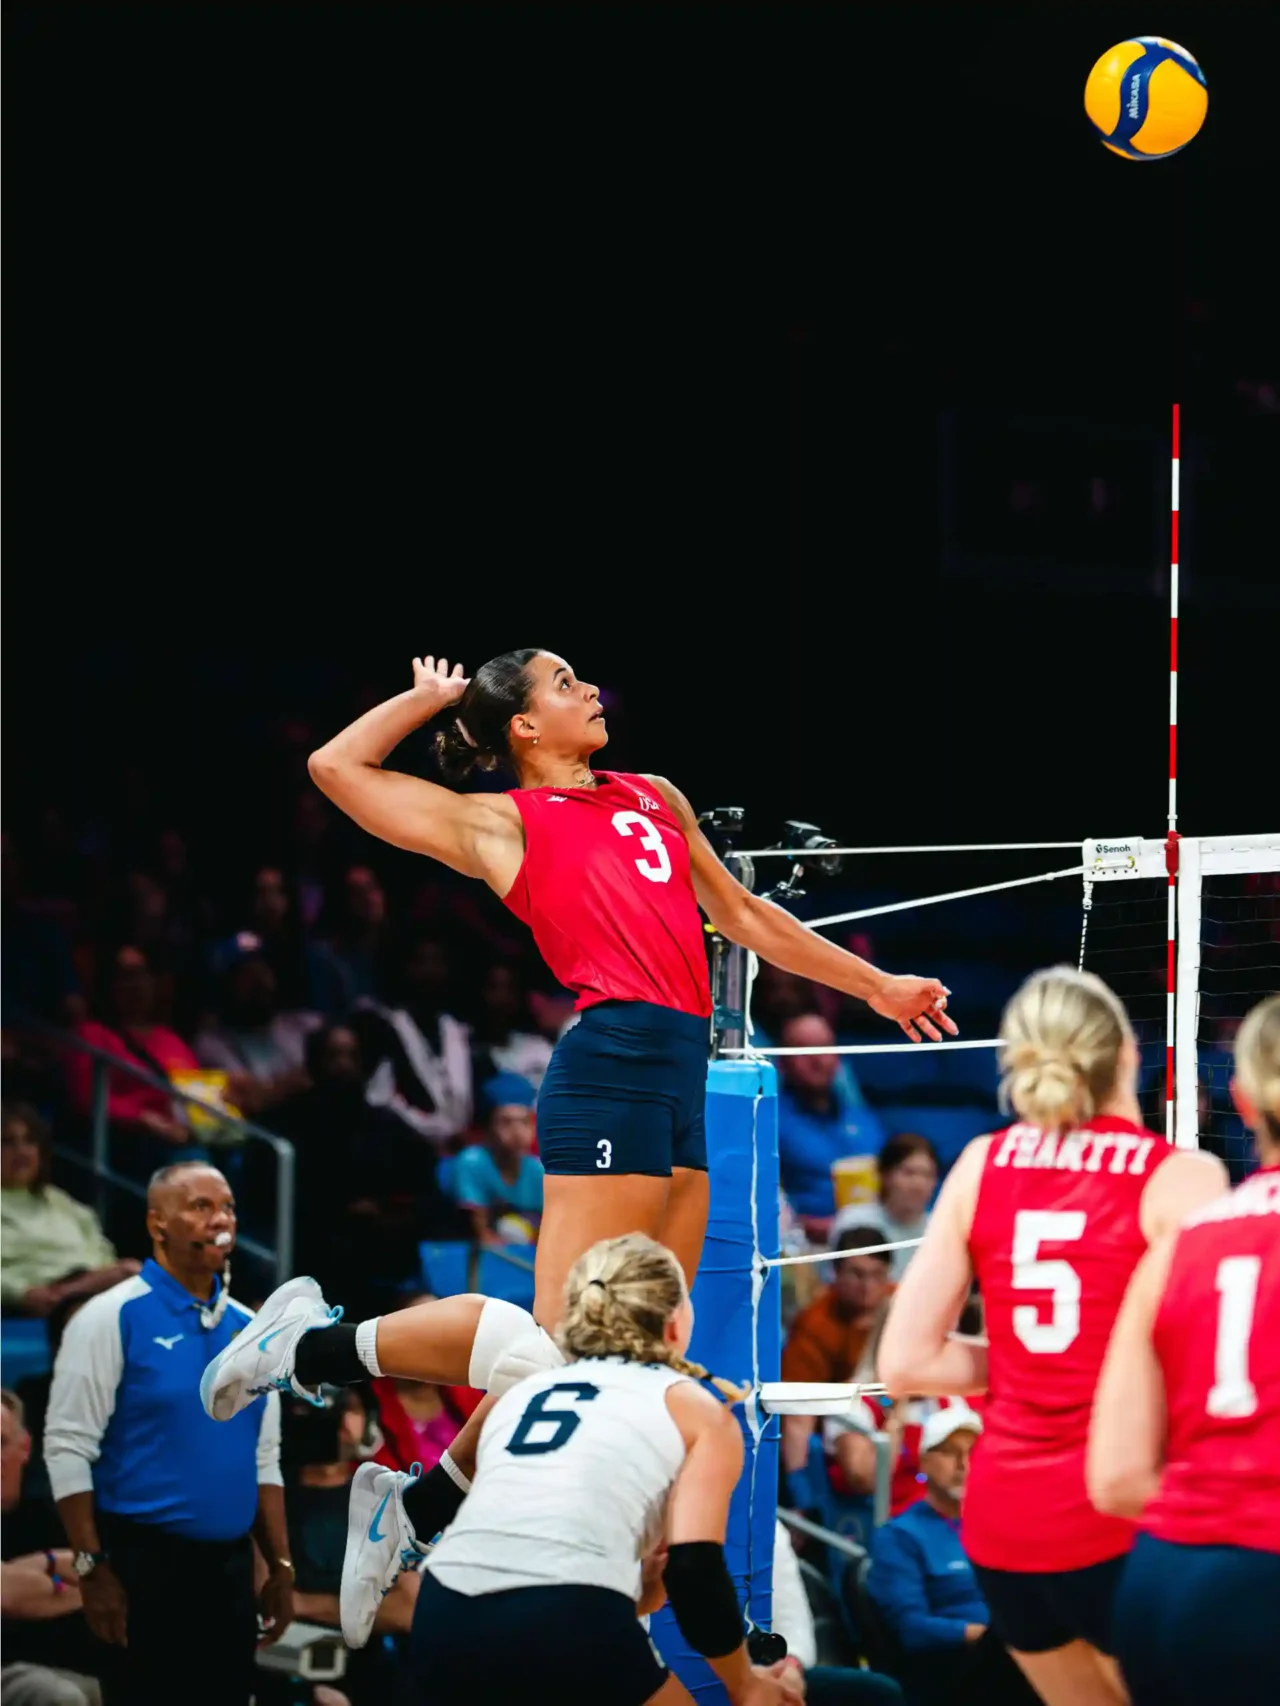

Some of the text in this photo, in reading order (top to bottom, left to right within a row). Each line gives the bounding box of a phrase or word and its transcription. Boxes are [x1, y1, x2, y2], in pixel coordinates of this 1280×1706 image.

[1127, 74, 1141, 119] MIKASA
[611, 811, 672, 883] 3
[1103, 844, 1131, 854] Senoh
[596, 1138, 612, 1168] 3
[1011, 1209, 1087, 1354] 5
[1205, 1254, 1262, 1418] 1
[505, 1382, 601, 1456] 6
